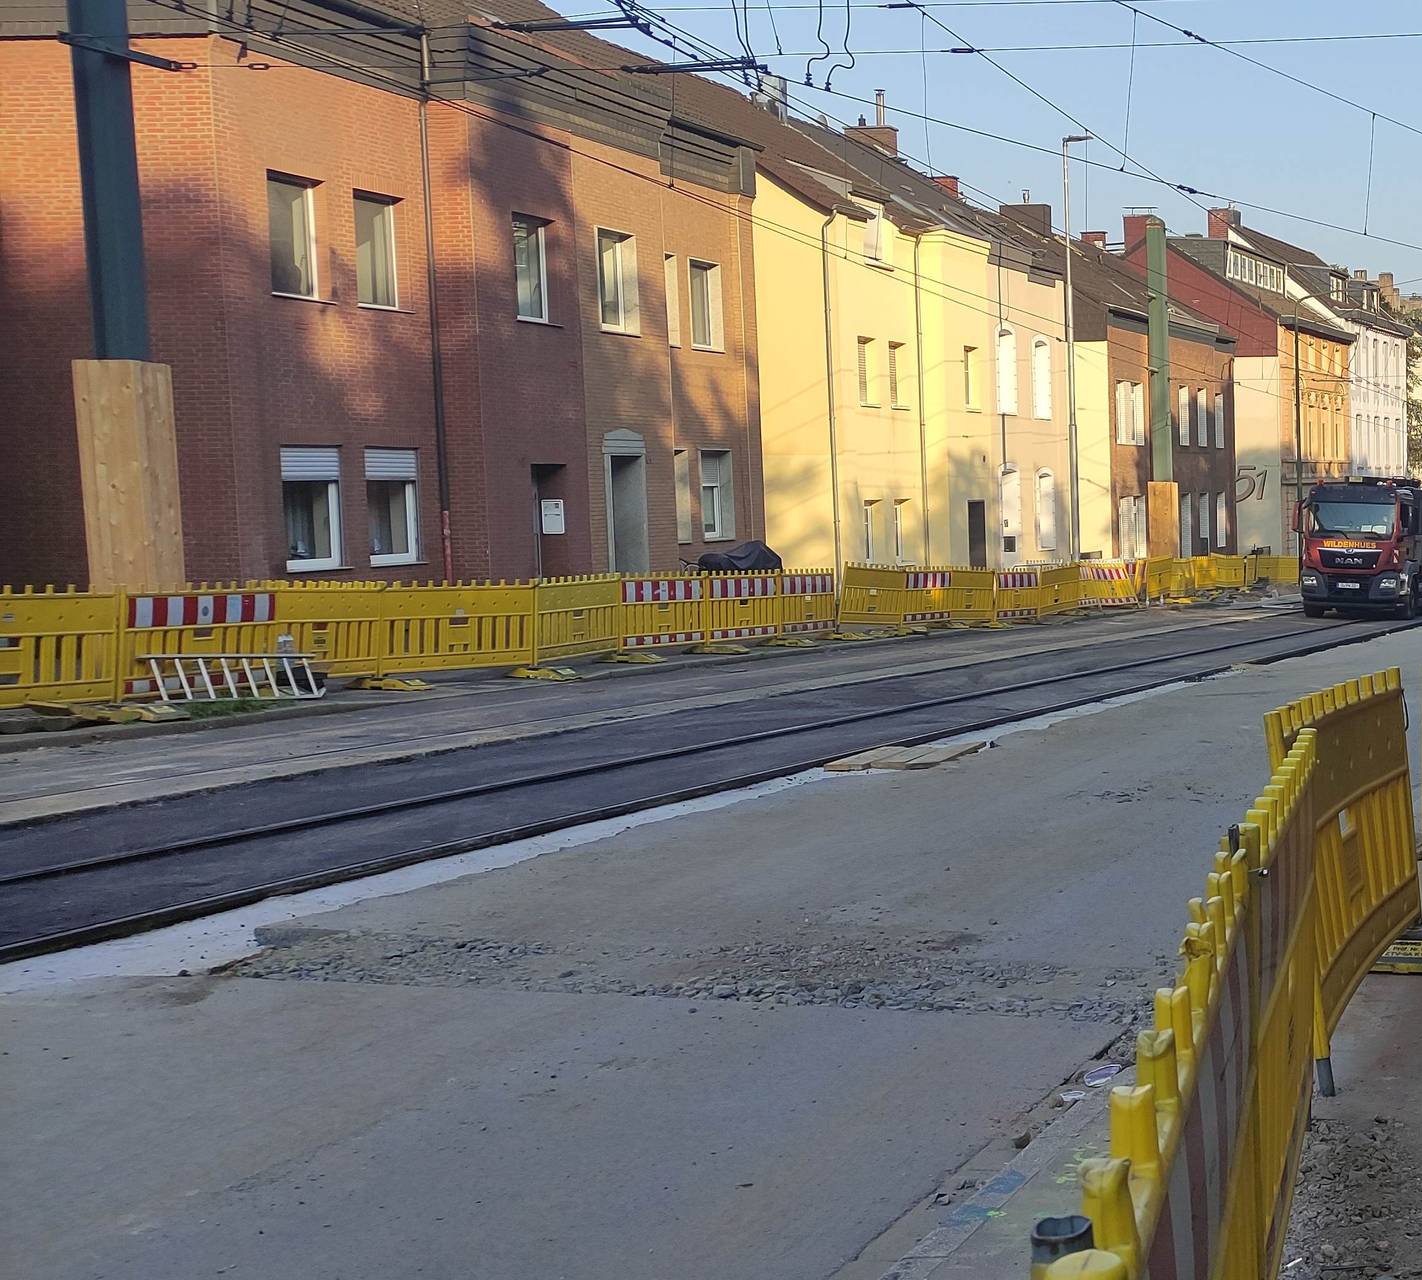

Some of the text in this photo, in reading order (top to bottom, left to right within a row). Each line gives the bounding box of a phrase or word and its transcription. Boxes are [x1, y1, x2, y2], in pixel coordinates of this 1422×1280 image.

[1236, 466, 1267, 503] 51
[1323, 540, 1376, 549] WILDENHUES
[1335, 557, 1363, 565] MAN
